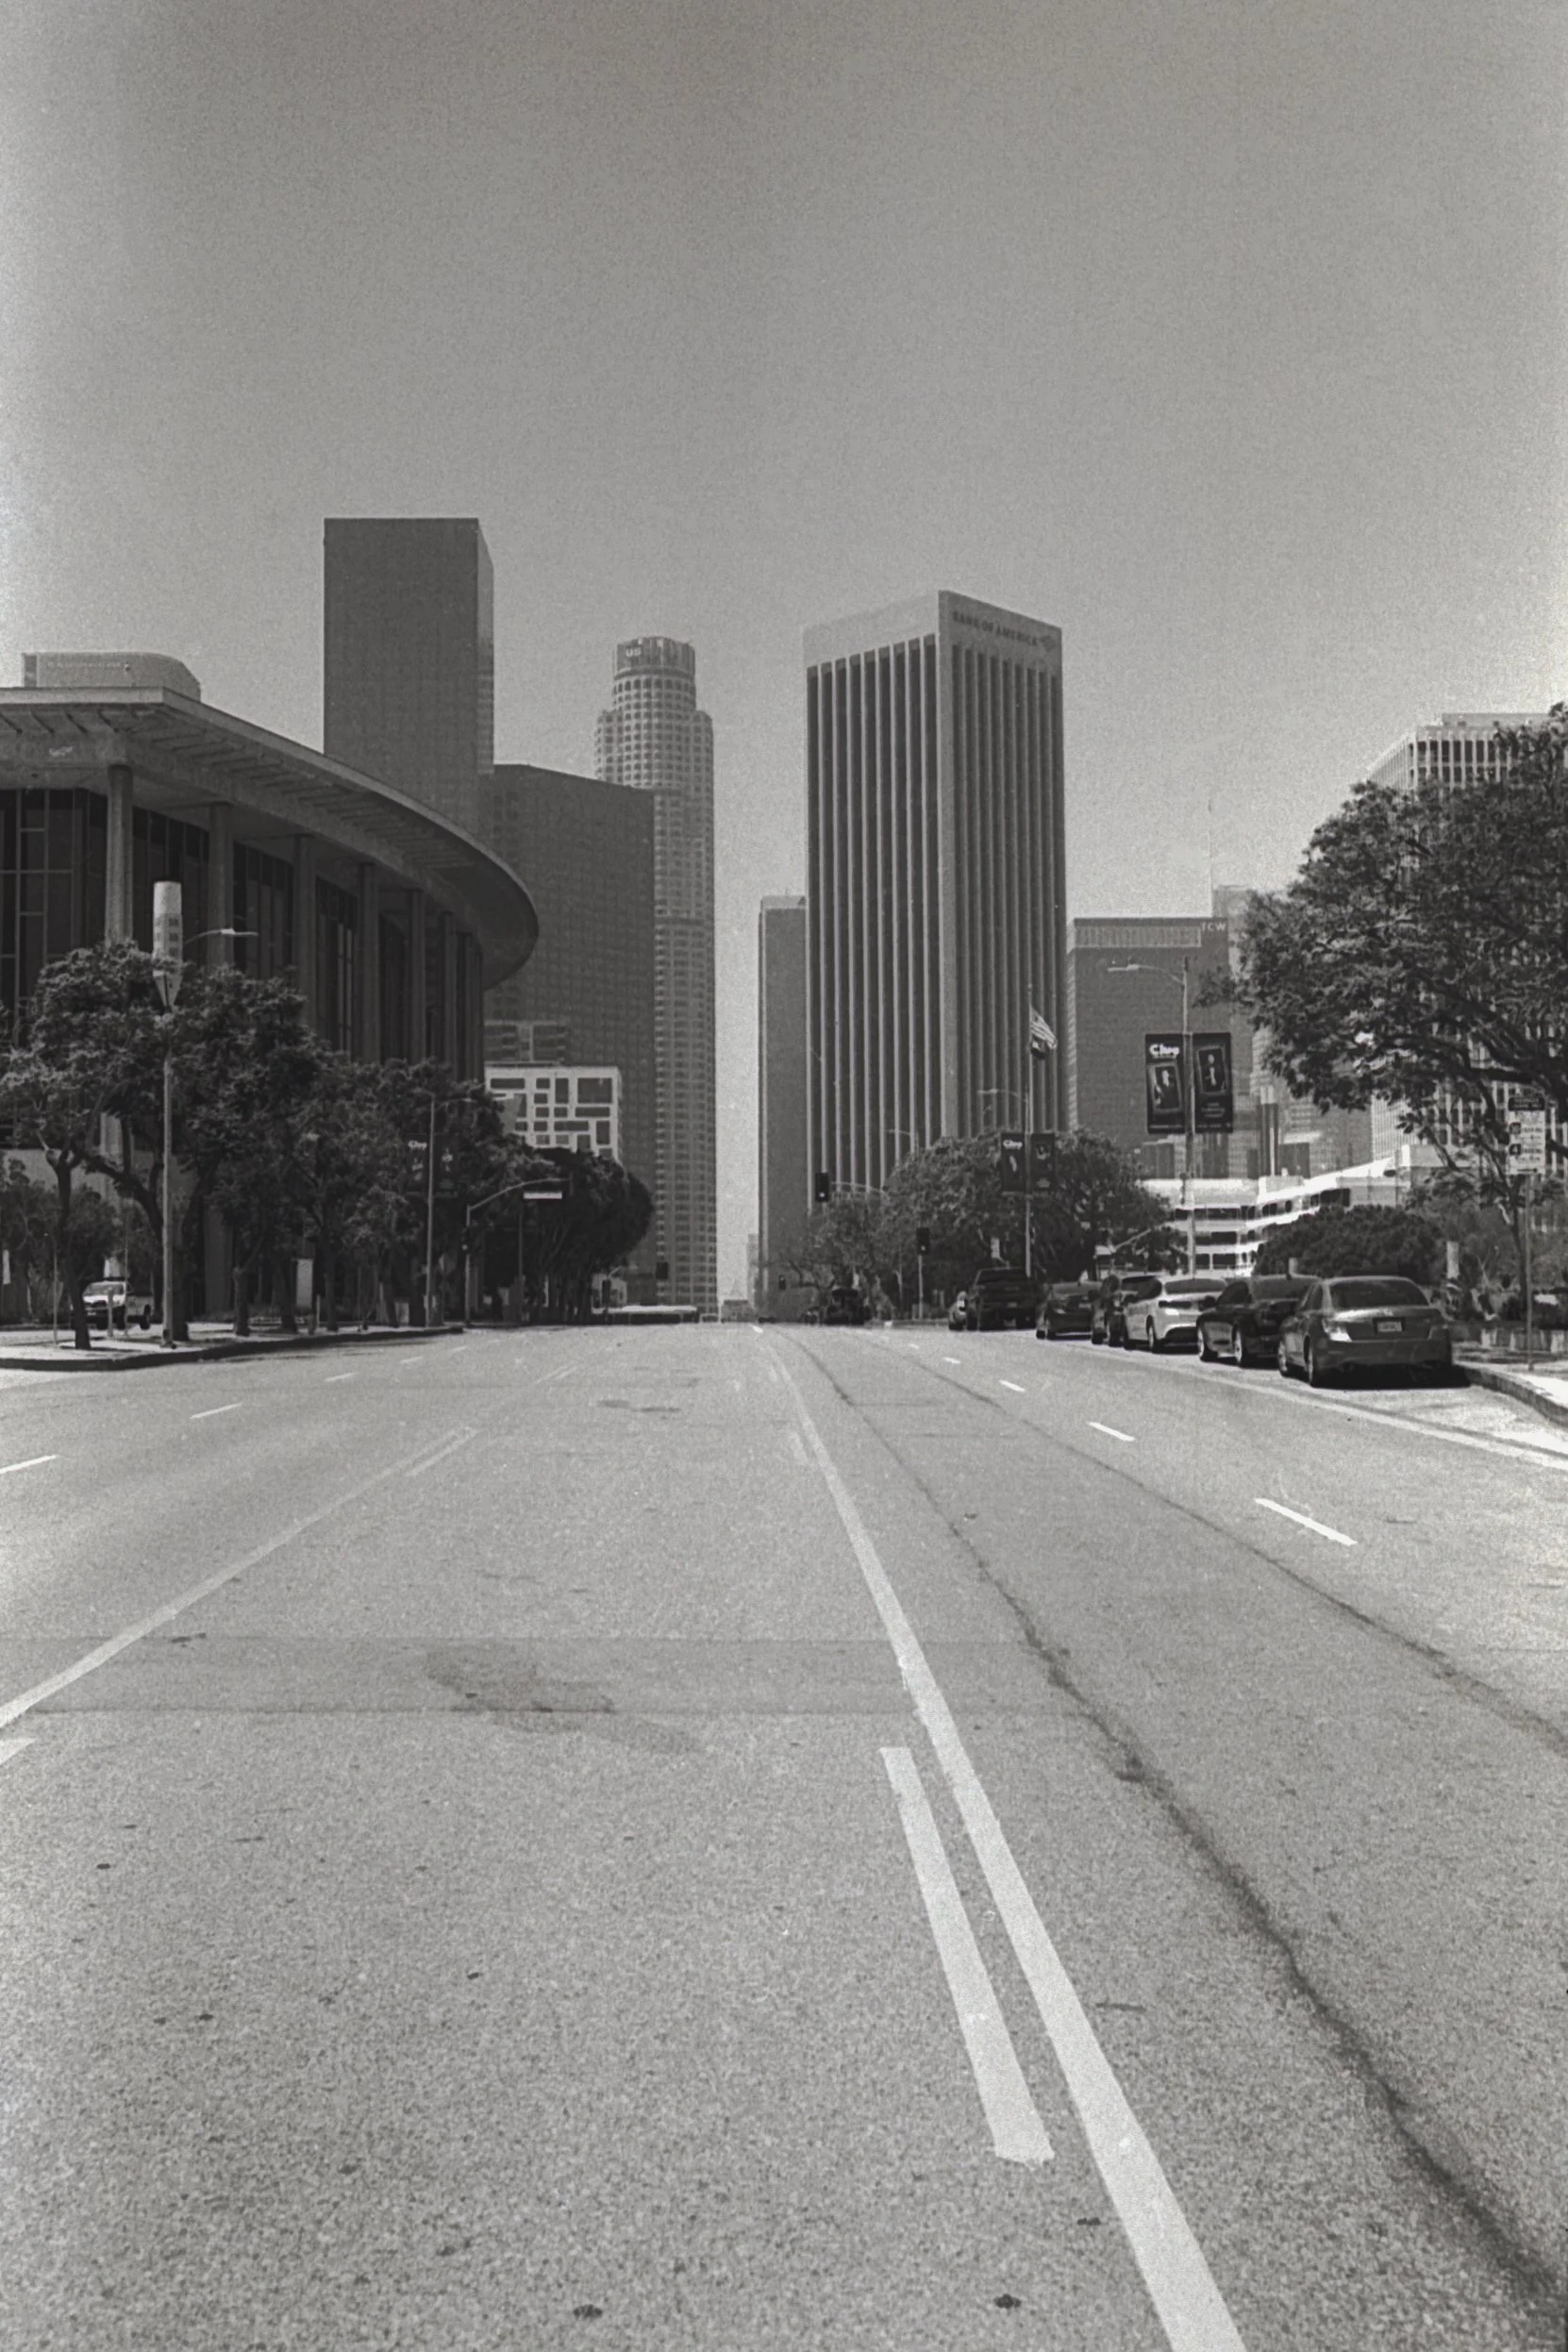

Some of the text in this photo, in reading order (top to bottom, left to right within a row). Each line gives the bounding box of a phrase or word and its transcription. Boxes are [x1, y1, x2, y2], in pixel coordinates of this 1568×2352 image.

[951, 610, 1038, 646] BANK OF AMERICA
[1200, 921, 1226, 932] TCW
